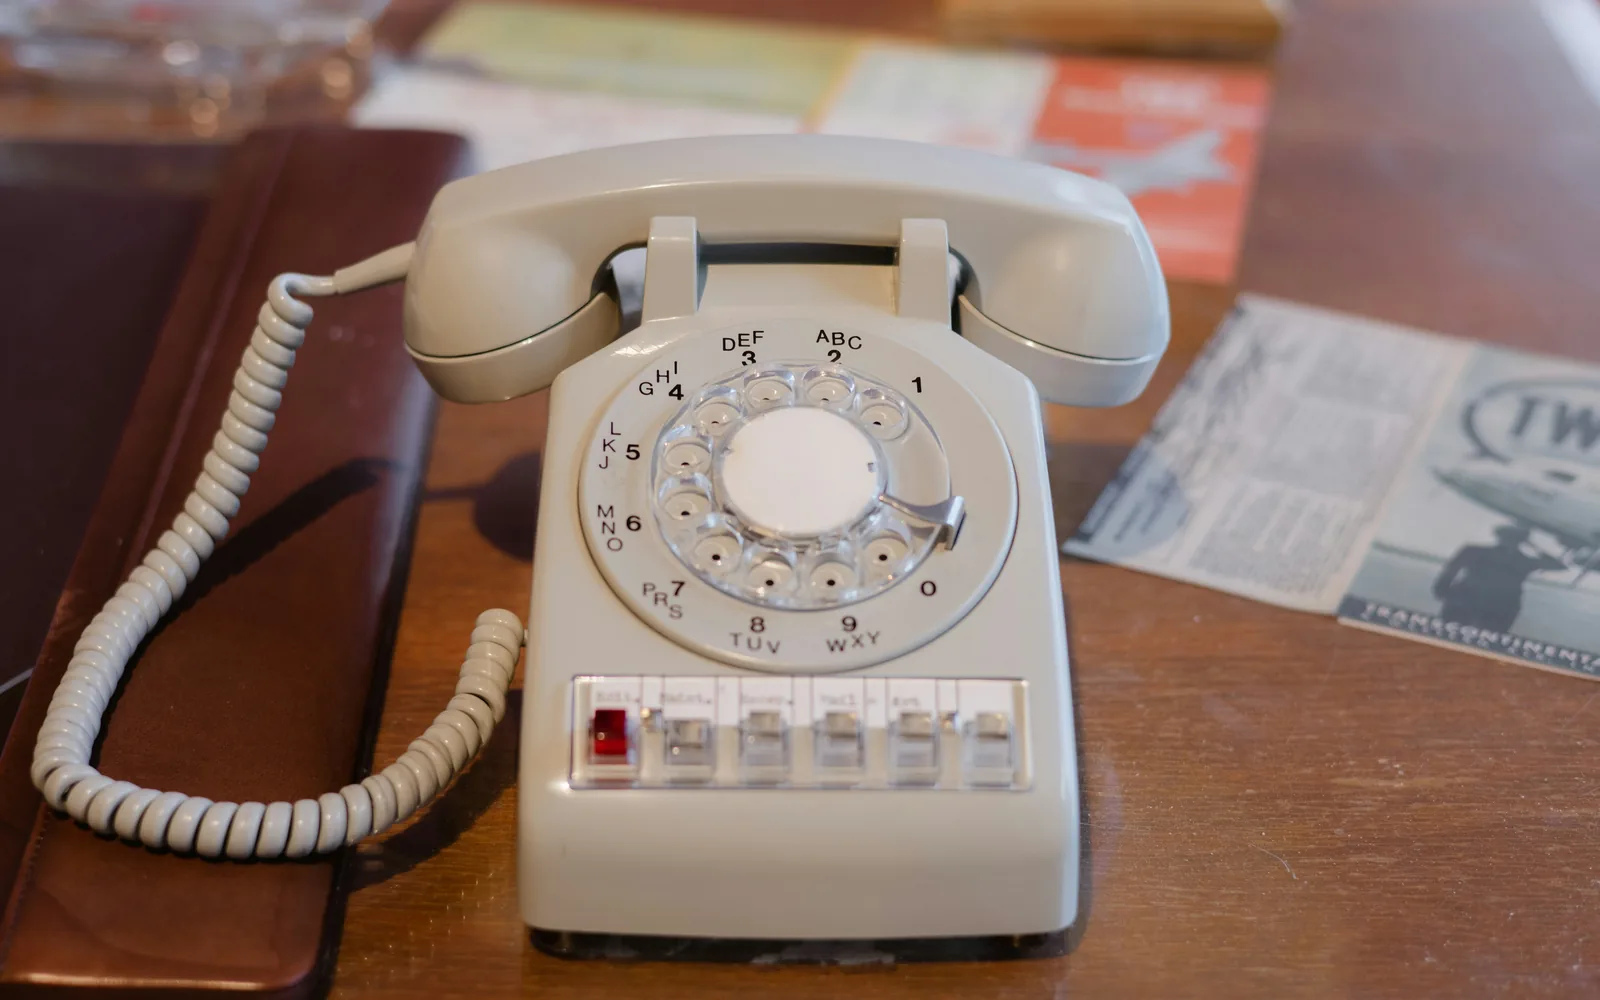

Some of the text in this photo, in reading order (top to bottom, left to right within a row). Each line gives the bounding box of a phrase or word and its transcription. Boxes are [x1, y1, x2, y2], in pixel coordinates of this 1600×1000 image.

[741, 350, 757, 367] 3
[827, 349, 842, 364] 2
[667, 383, 685, 401] 4
[911, 376, 922, 394] 1
[625, 443, 641, 461] 5
[625, 515, 642, 532] 6
[671, 580, 686, 597] 7
[749, 616, 765, 633] 8
[841, 615, 857, 632] 9
